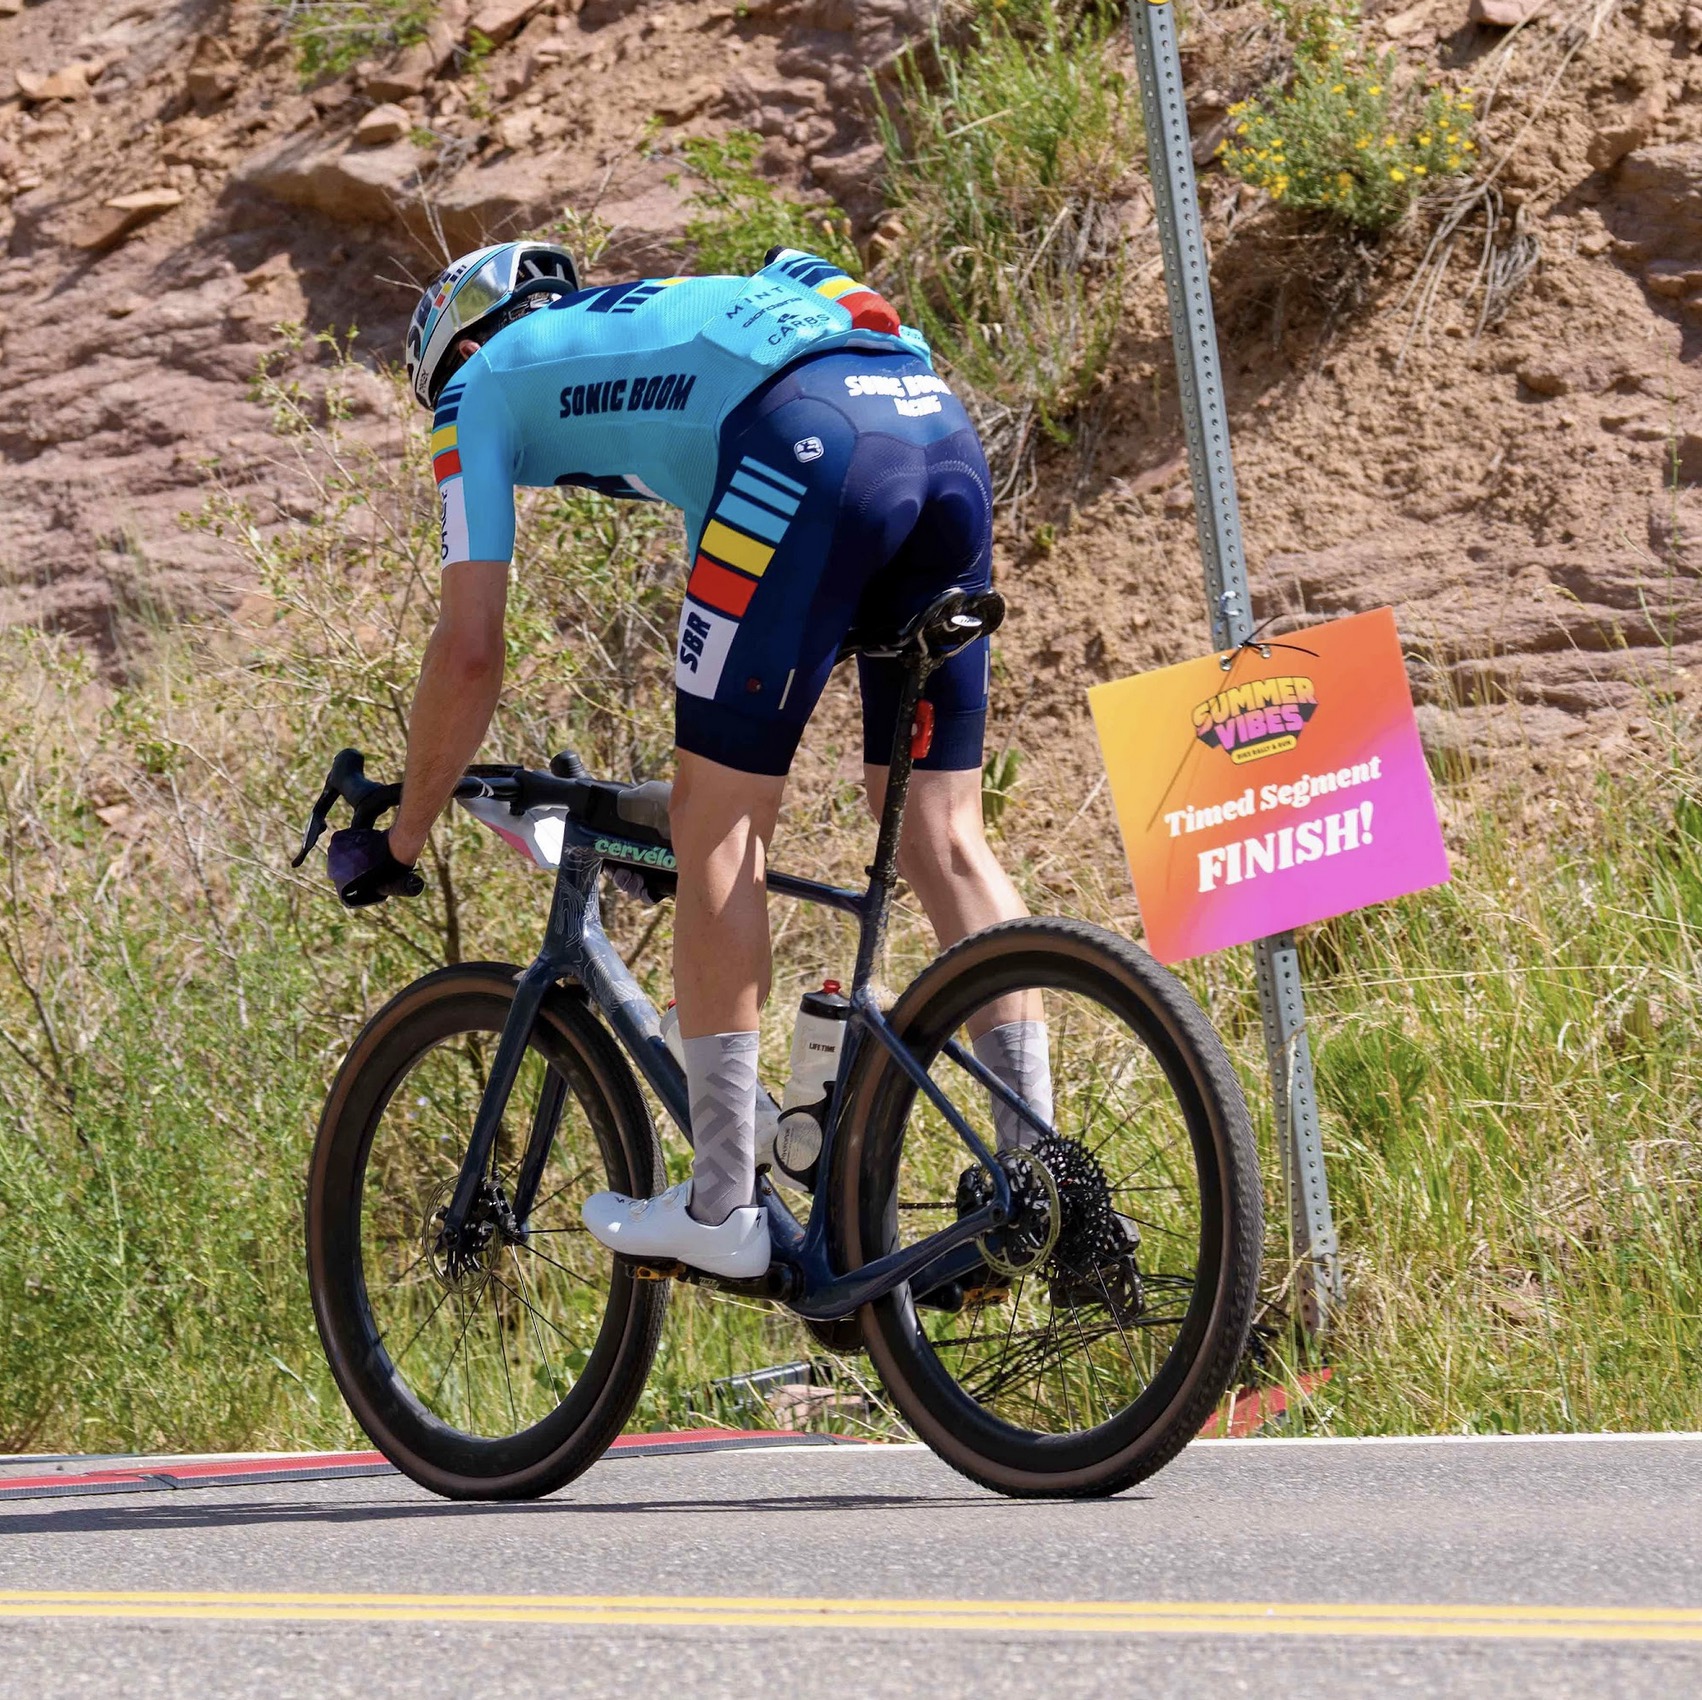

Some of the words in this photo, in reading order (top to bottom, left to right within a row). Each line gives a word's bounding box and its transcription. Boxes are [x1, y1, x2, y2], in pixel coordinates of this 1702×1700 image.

[726, 285, 784, 319] MINT
[768, 313, 830, 346] CARBS
[560, 379, 628, 418] SONIC
[627, 373, 697, 411] BOOM
[680, 611, 711, 674] SBR
[1192, 676, 1318, 736] SUMMER
[1214, 704, 1304, 750] VIBES
[1164, 788, 1255, 837] Timed
[1259, 756, 1382, 811] Segment
[594, 838, 677, 869] cervélo
[1197, 800, 1374, 893] FINISH!
